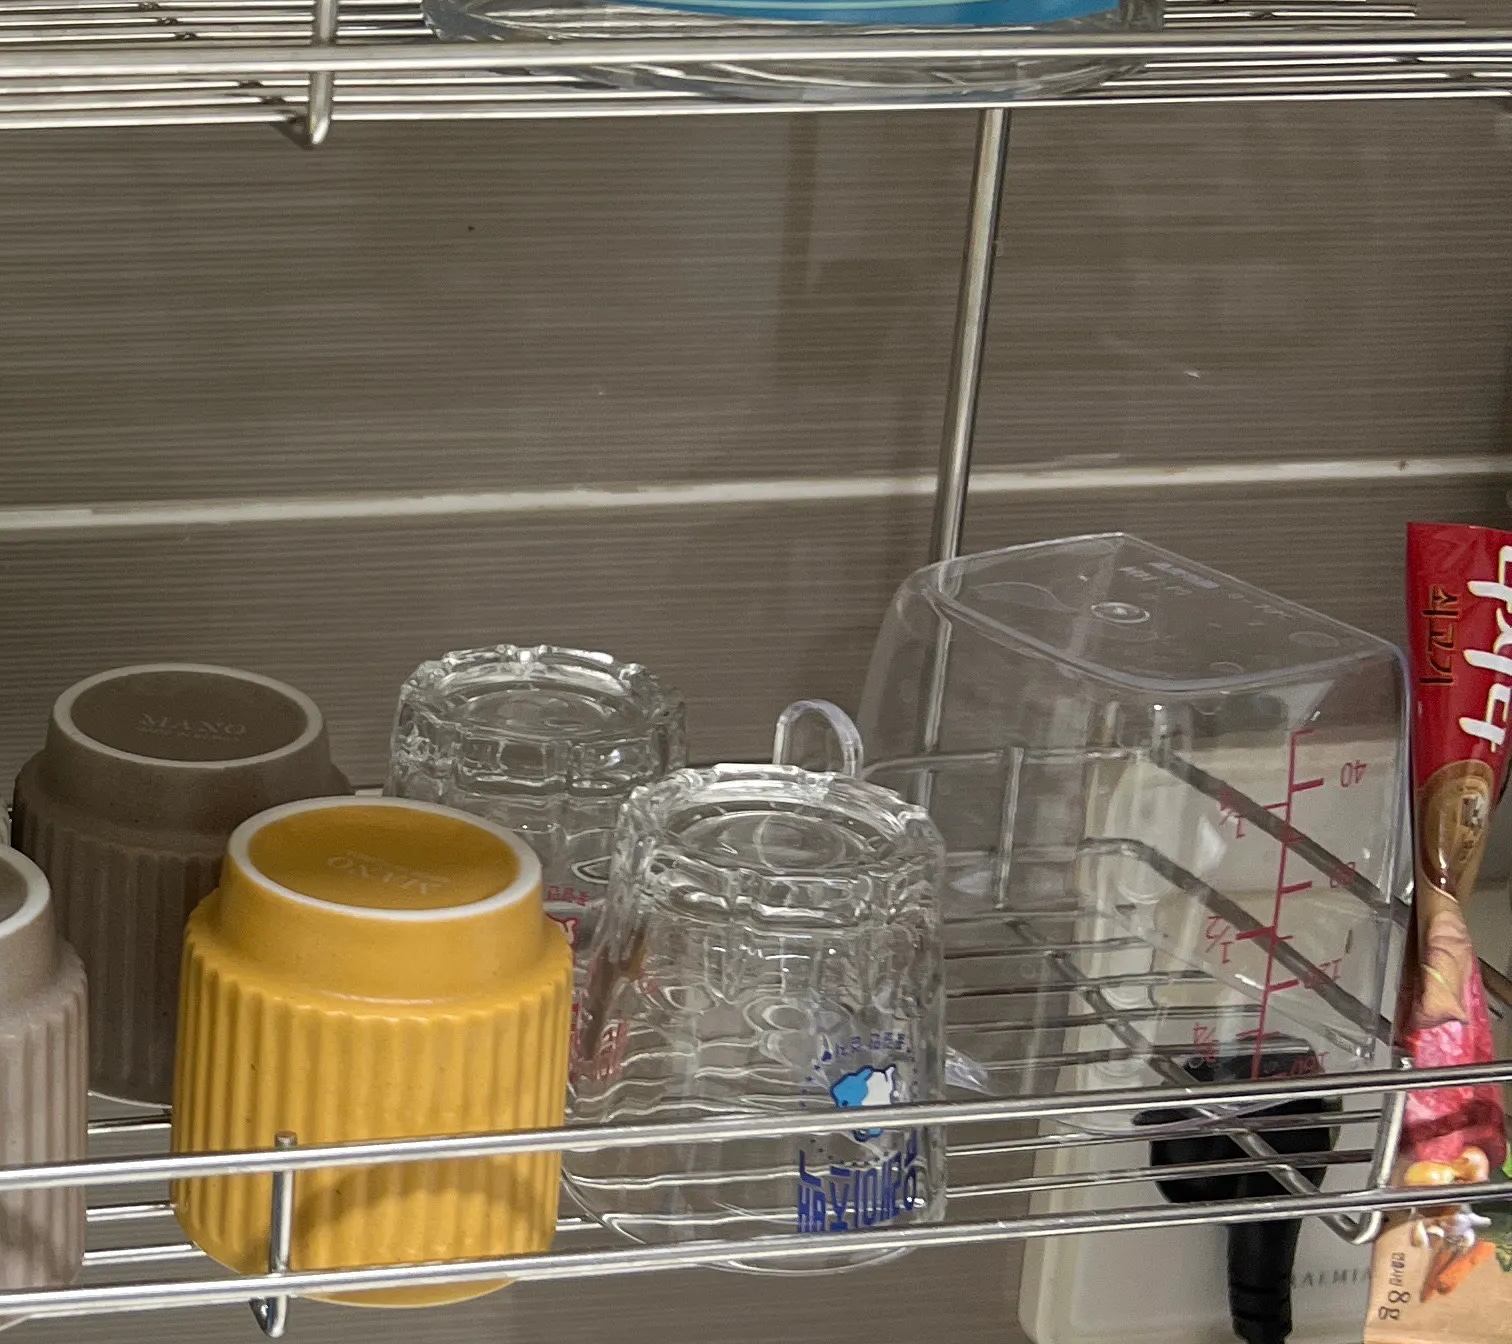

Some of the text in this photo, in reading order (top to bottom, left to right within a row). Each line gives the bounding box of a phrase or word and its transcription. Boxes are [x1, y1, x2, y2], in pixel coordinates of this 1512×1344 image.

[1420, 585, 1462, 686] 쇠고기
[138, 712, 247, 734] MANO
[1341, 760, 1367, 787] 40
